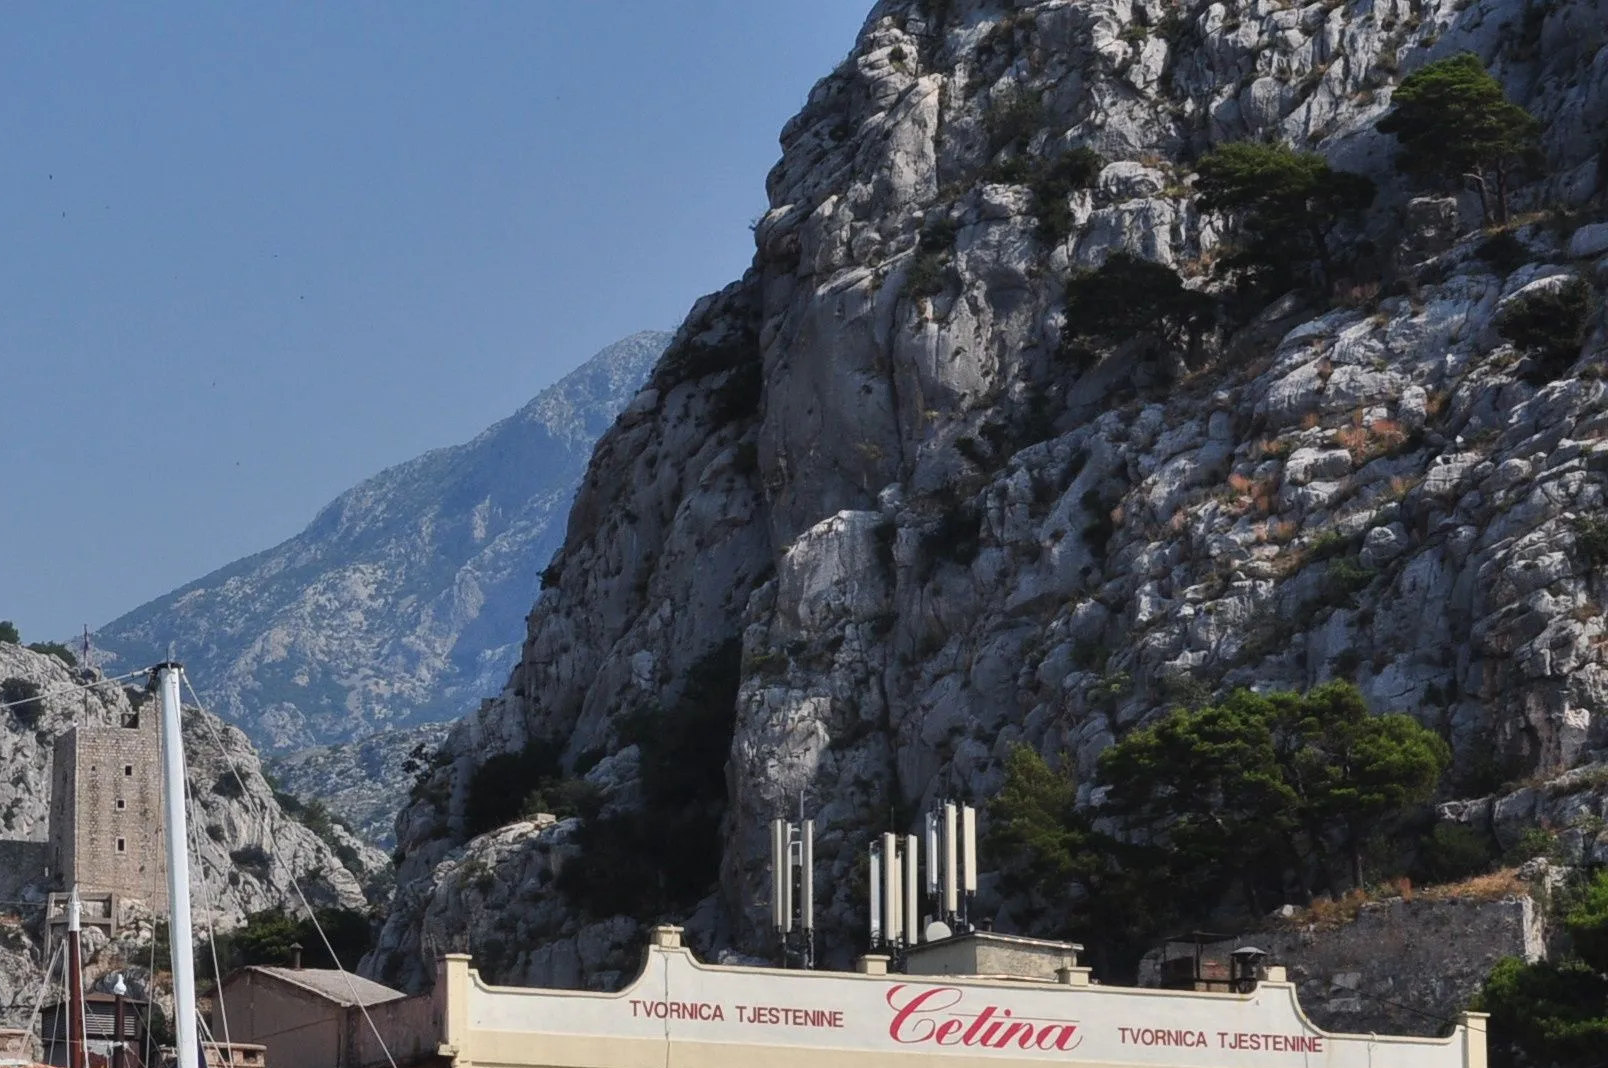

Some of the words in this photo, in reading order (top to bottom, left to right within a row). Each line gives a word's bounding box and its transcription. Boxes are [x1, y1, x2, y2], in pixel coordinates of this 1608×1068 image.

[629, 1000, 725, 1022] TVORNICA
[735, 1005, 845, 1029] TJESTENINE
[1118, 1026, 1209, 1048] TVORNICA
[1217, 1031, 1324, 1054] TJESTENINE
